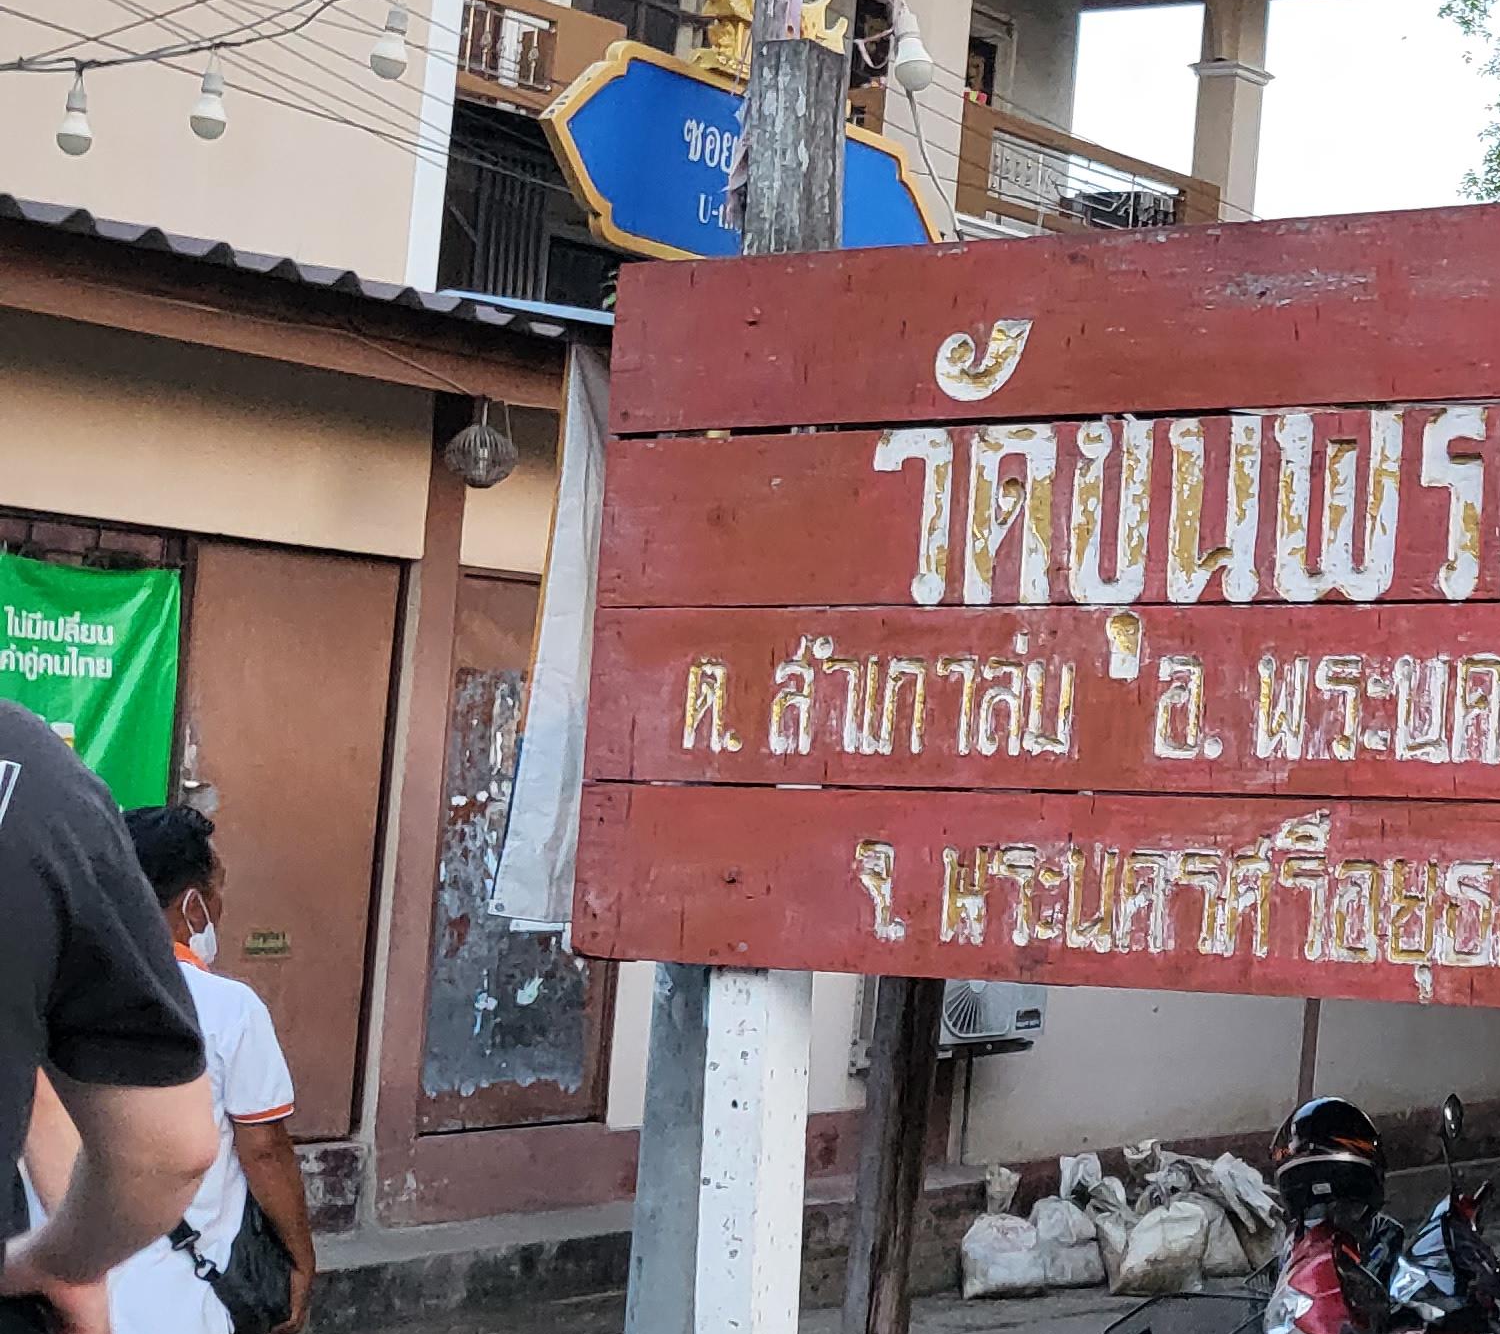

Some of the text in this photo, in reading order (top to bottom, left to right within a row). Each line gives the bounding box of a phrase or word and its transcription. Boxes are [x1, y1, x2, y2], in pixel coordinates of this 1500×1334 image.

[3, 605, 114, 646] ไม่มีเปลี่ยน
[682, 657, 742, 754] ต.
[768, 630, 1076, 759] สำเภาล่ม
[1154, 656, 1224, 760] อ.
[854, 840, 905, 942] จ.
